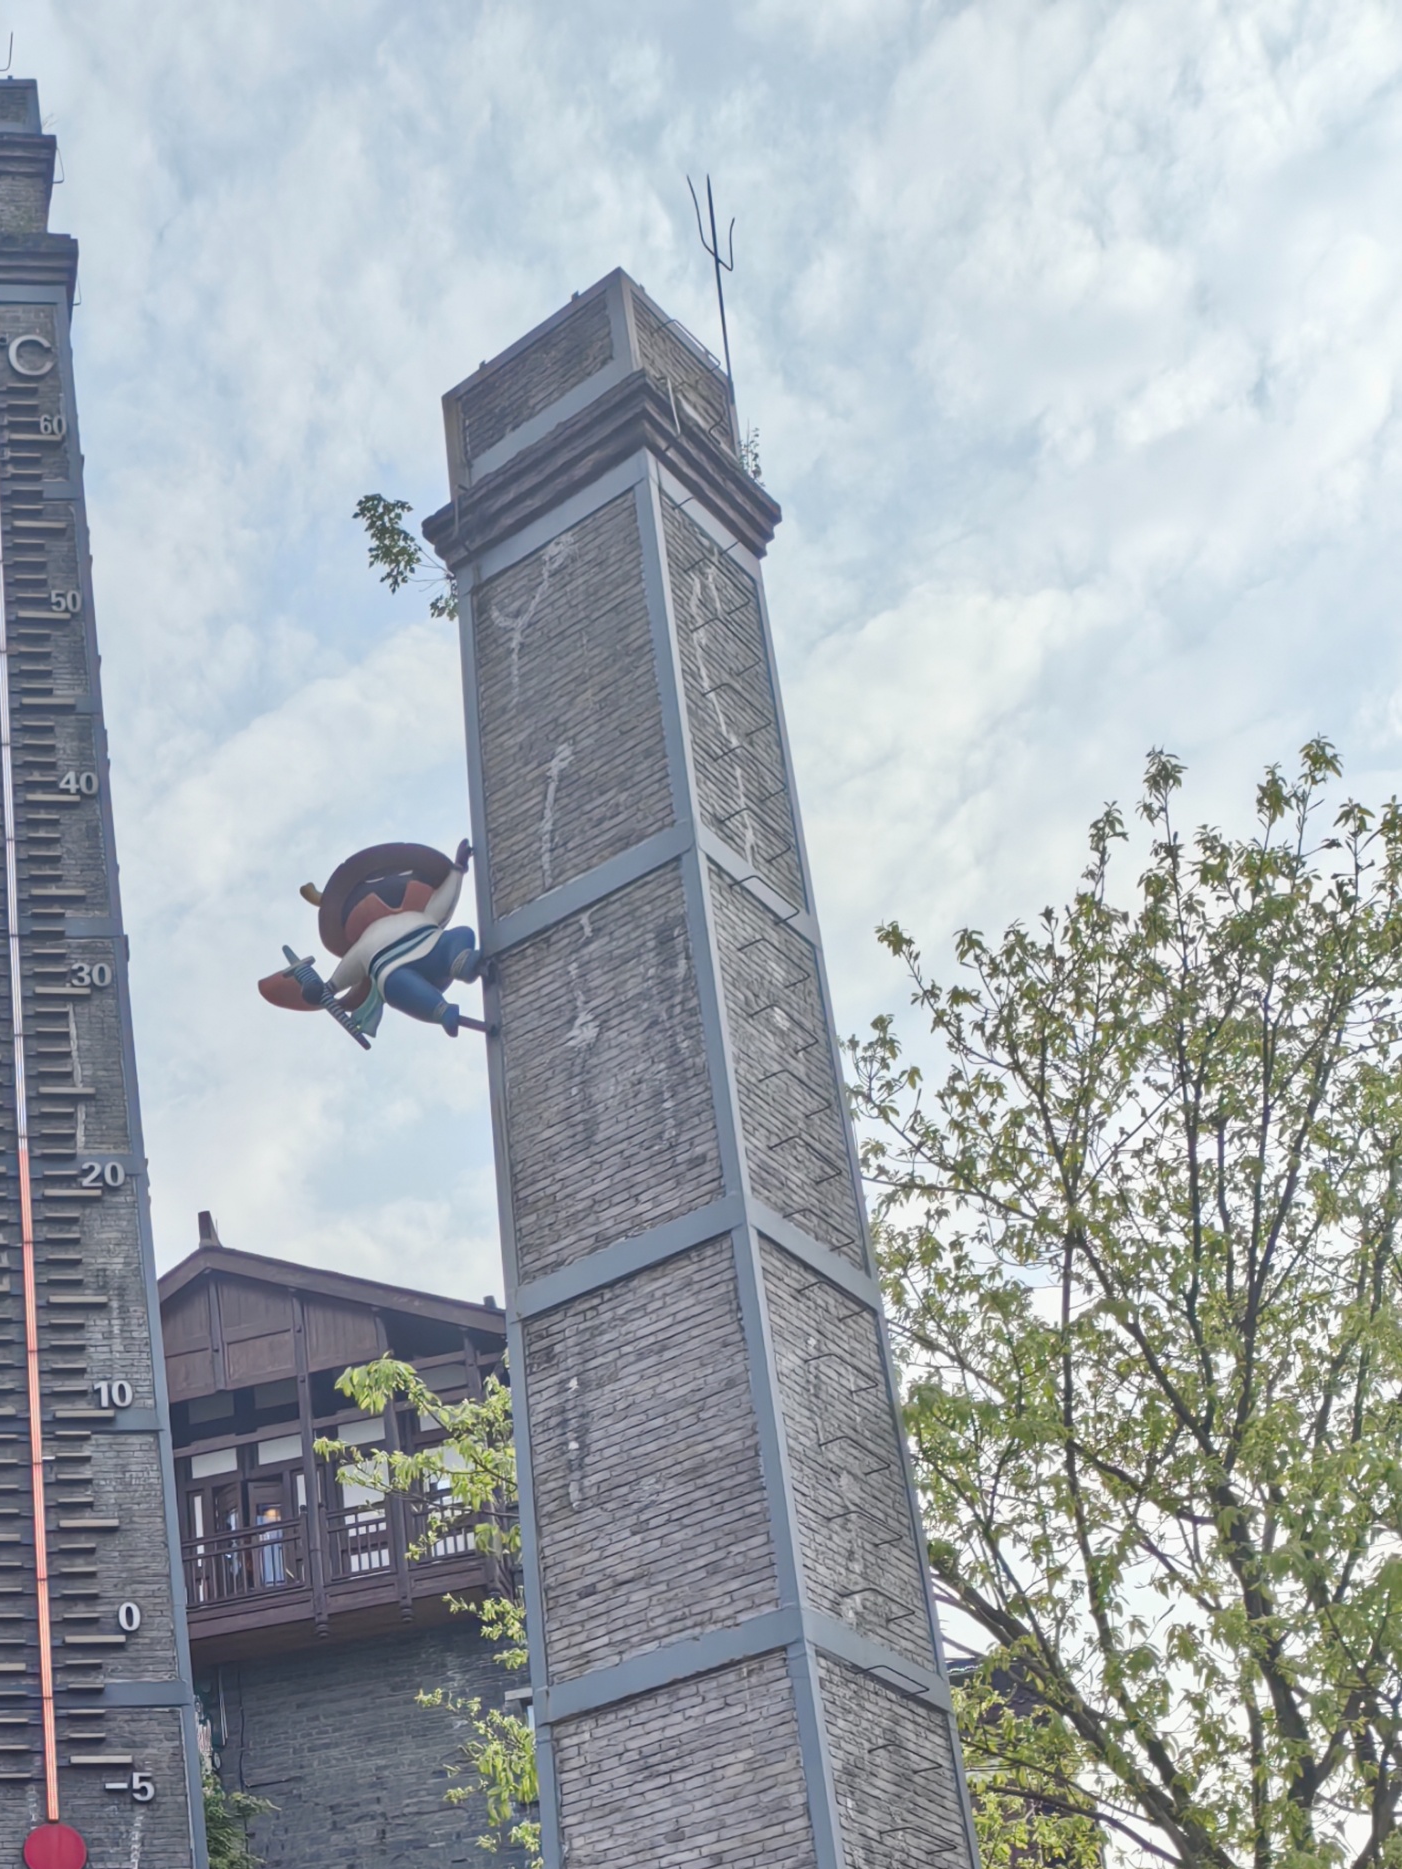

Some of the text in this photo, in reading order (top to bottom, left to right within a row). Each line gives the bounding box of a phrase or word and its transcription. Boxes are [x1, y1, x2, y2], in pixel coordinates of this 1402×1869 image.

[39, 414, 68, 437] 60
[50, 590, 82, 614] 50
[59, 772, 99, 795] 40
[70, 962, 113, 988] 30
[81, 1160, 126, 1188] 20
[94, 1379, 134, 1408] 10
[117, 1602, 142, 1632] 0
